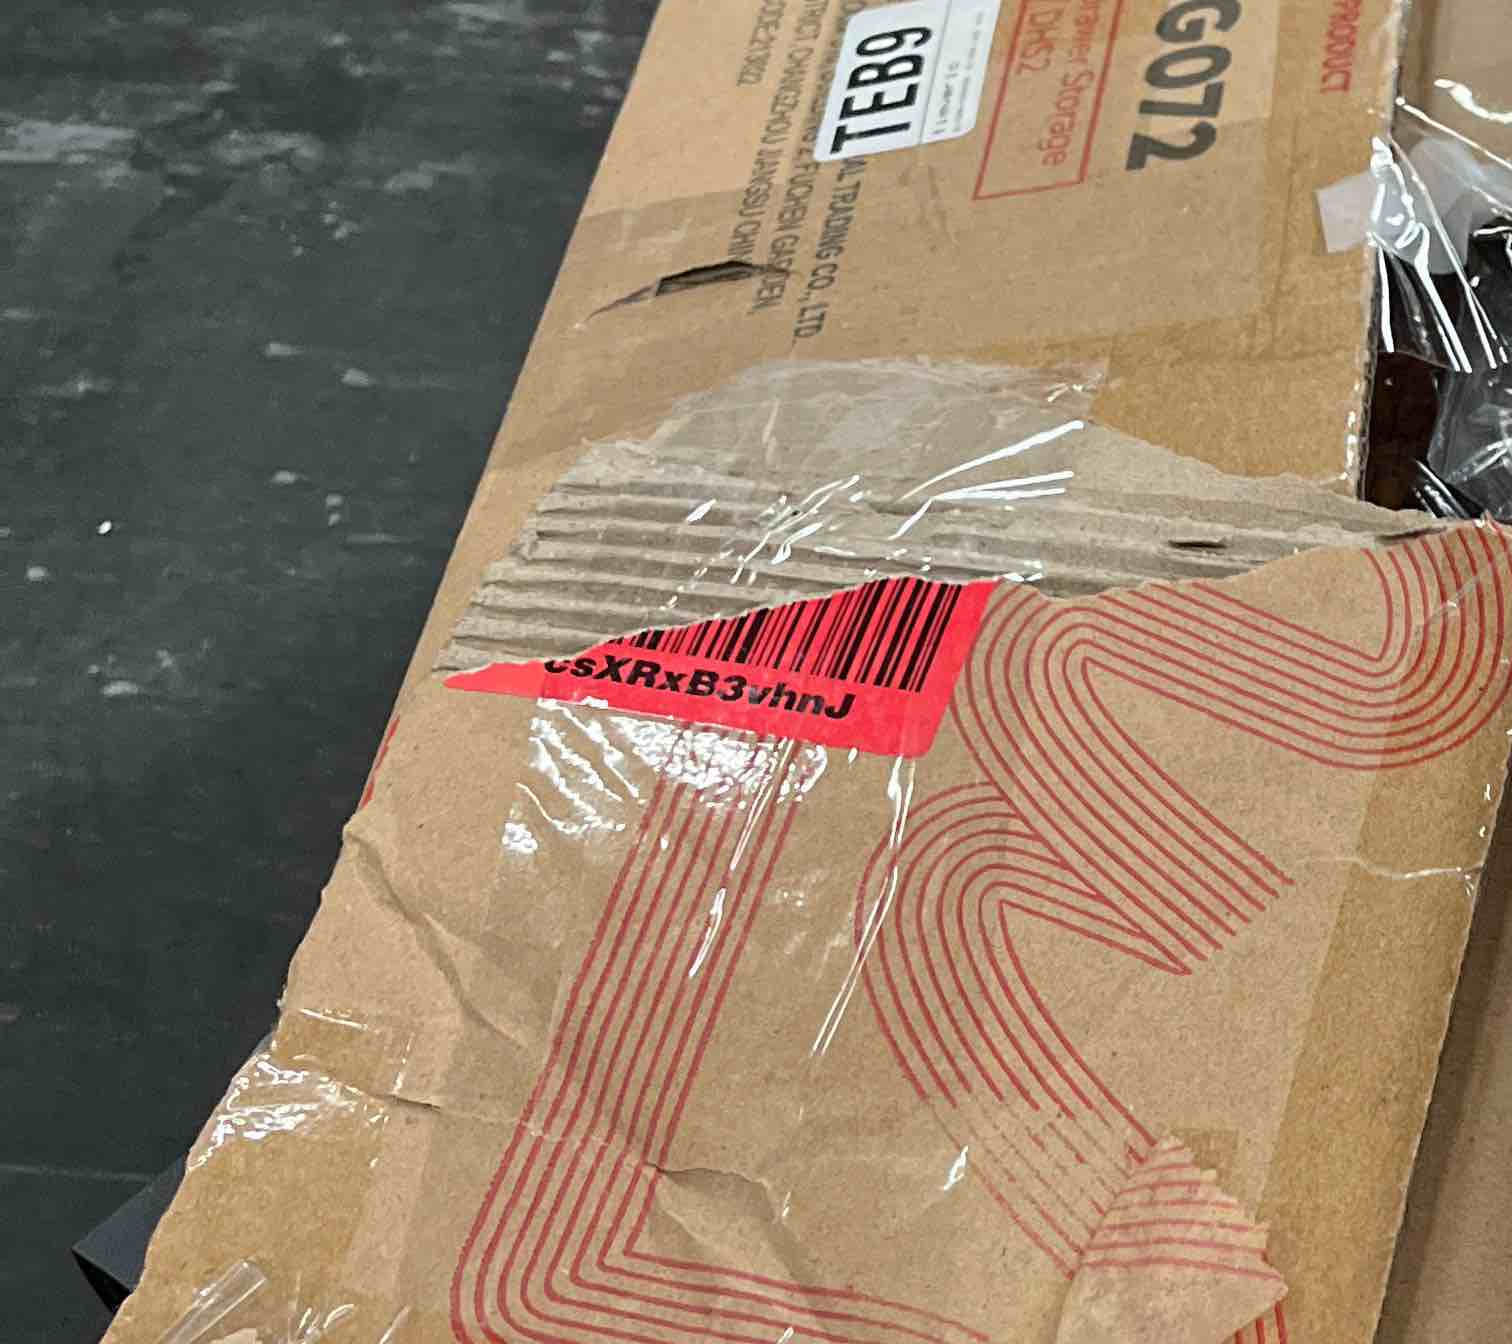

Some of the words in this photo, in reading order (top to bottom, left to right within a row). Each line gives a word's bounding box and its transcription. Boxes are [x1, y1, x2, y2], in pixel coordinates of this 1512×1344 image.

[830, 26, 933, 154] TEB9
[1320, 0, 1363, 94] PRODUCT
[1038, 71, 1096, 167] Storage
[814, 181, 862, 261] TRADING
